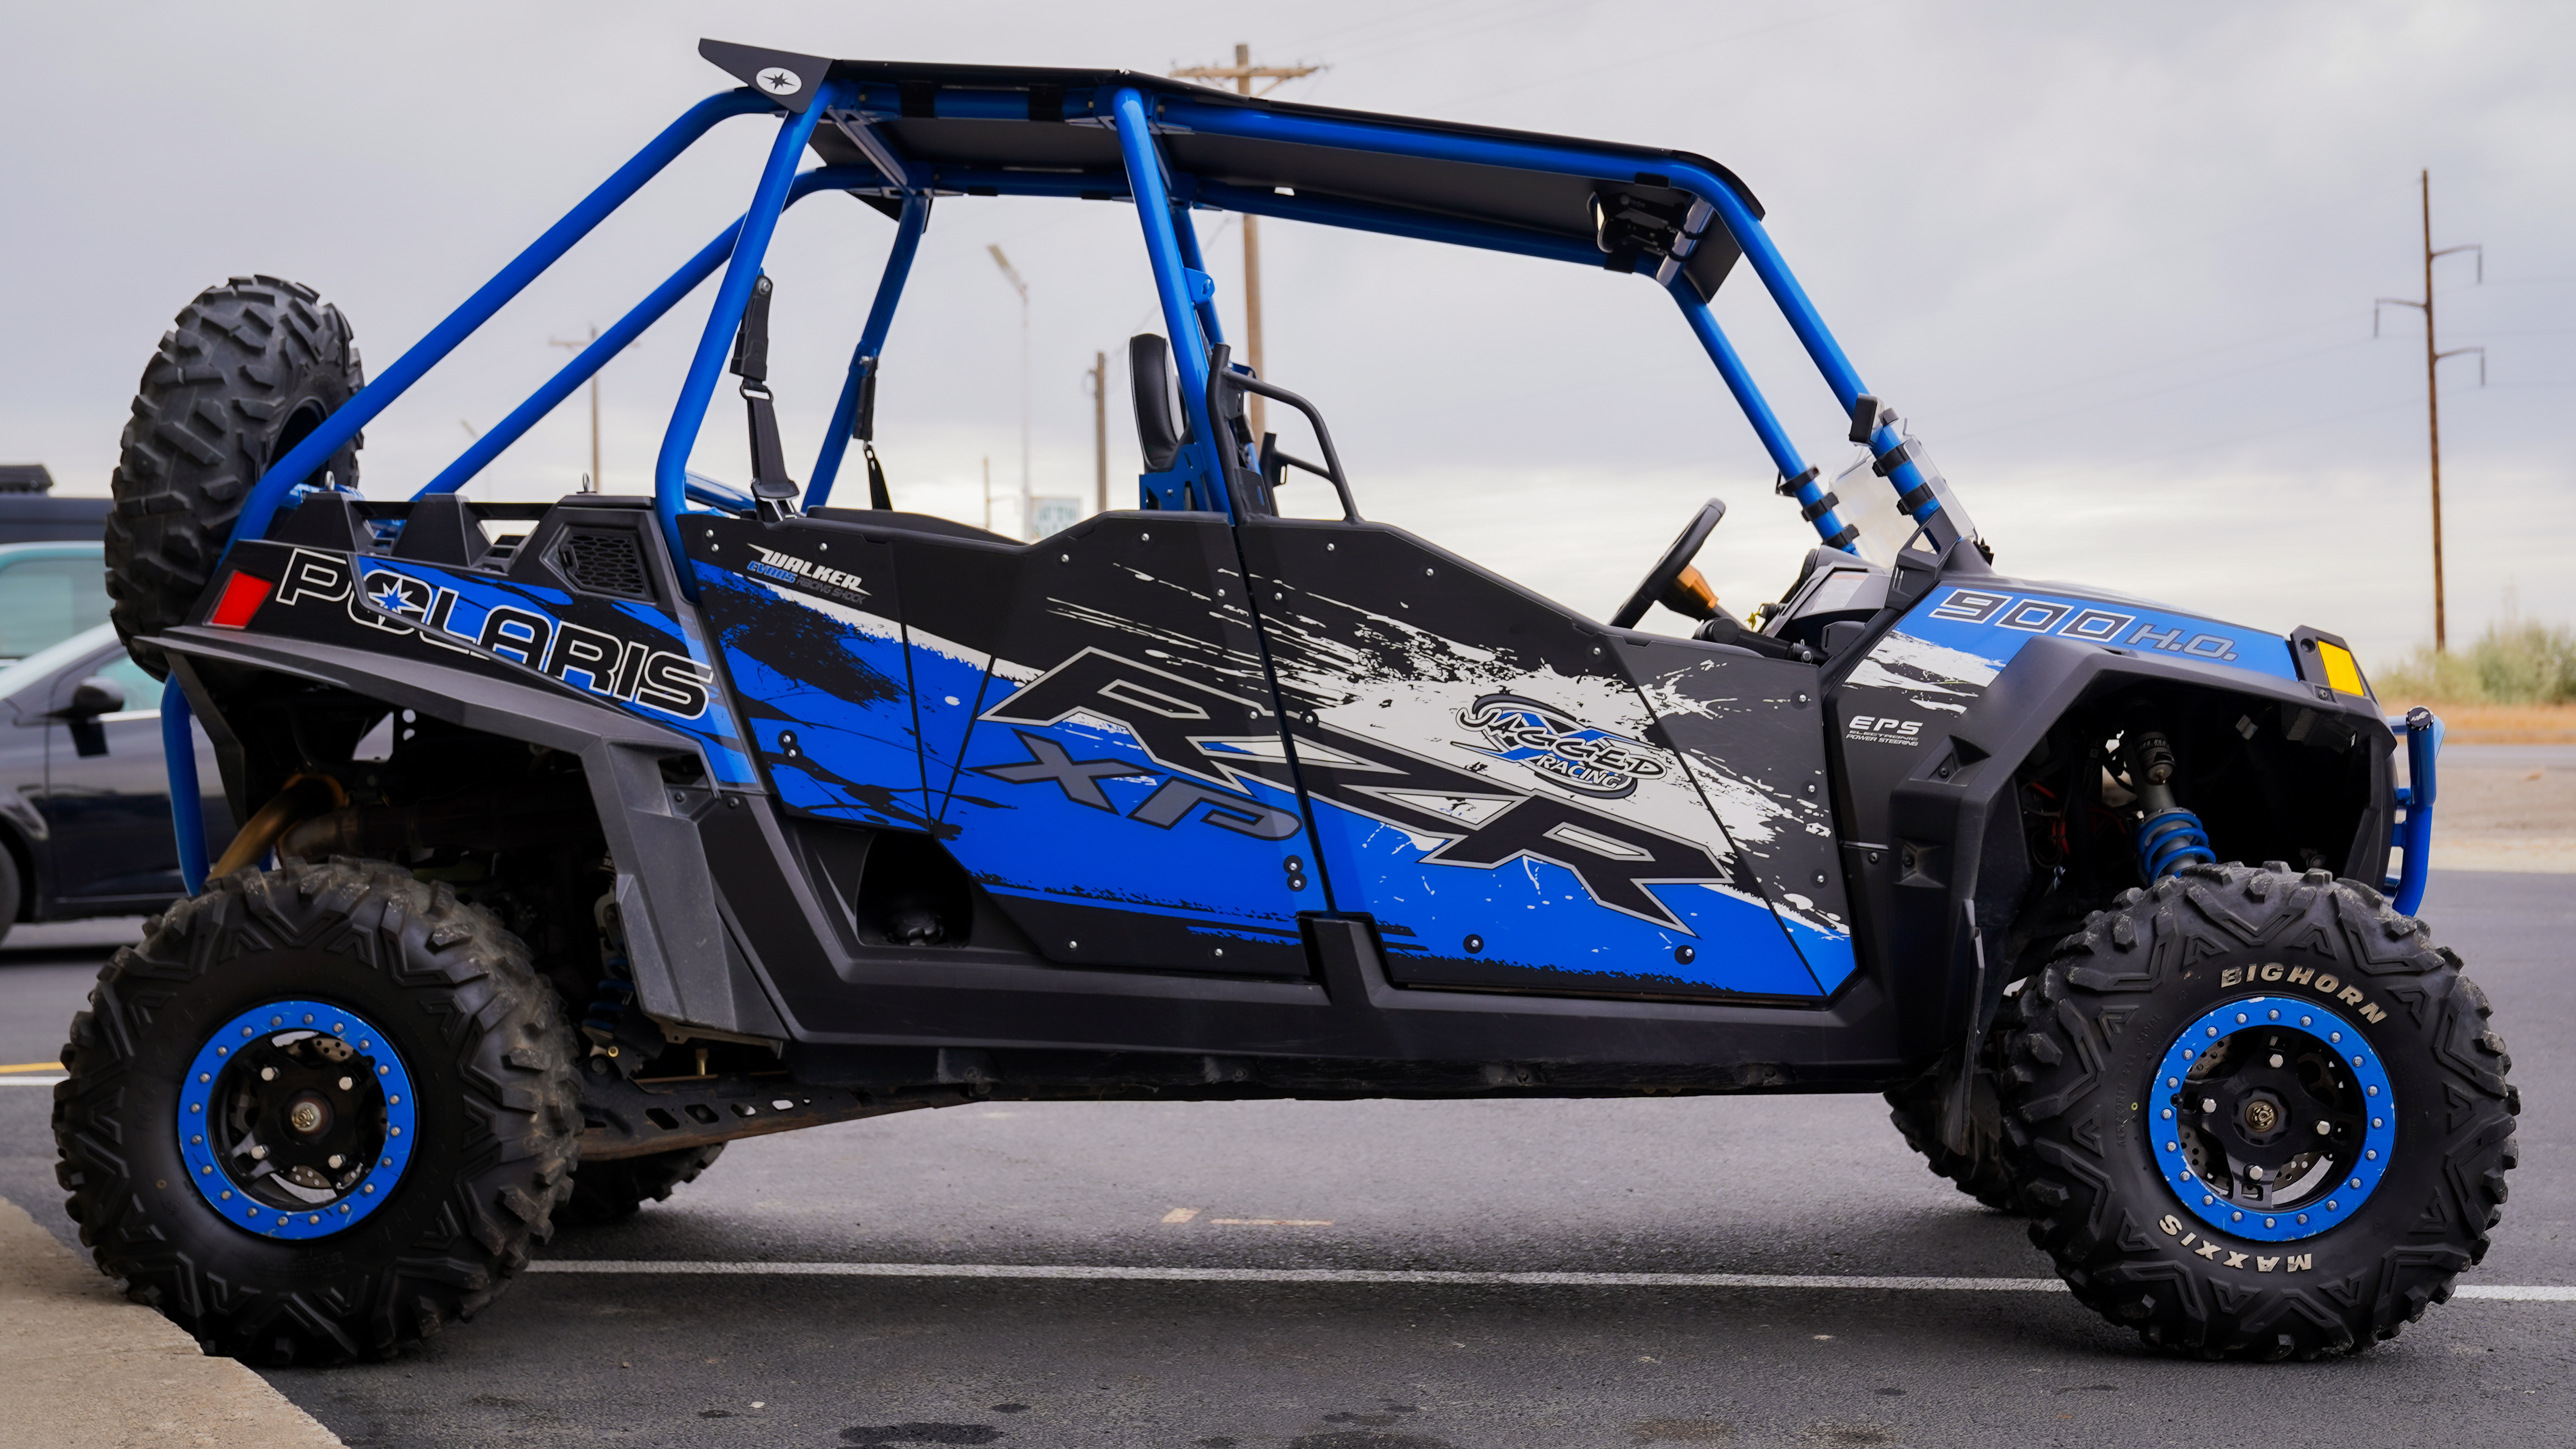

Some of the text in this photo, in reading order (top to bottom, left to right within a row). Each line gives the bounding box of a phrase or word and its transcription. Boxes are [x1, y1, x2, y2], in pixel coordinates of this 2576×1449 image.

[747, 543, 872, 596] WALKER
[747, 560, 866, 605] EVANS RACING SHOCK
[275, 548, 713, 720] POLARIS
[1928, 588, 2239, 662] 900 H.O.
[1456, 707, 1667, 779] JAGGED
[1846, 734, 1919, 747] POWER STEERING
[1849, 715, 1923, 735] EPS
[1849, 730, 1919, 741] ELECTRONIC
[965, 727, 1303, 841] XP
[1536, 754, 1622, 789] RACING
[2221, 962, 2388, 1025] BIGHORN
[2159, 1214, 2312, 1272] MAXXIS
